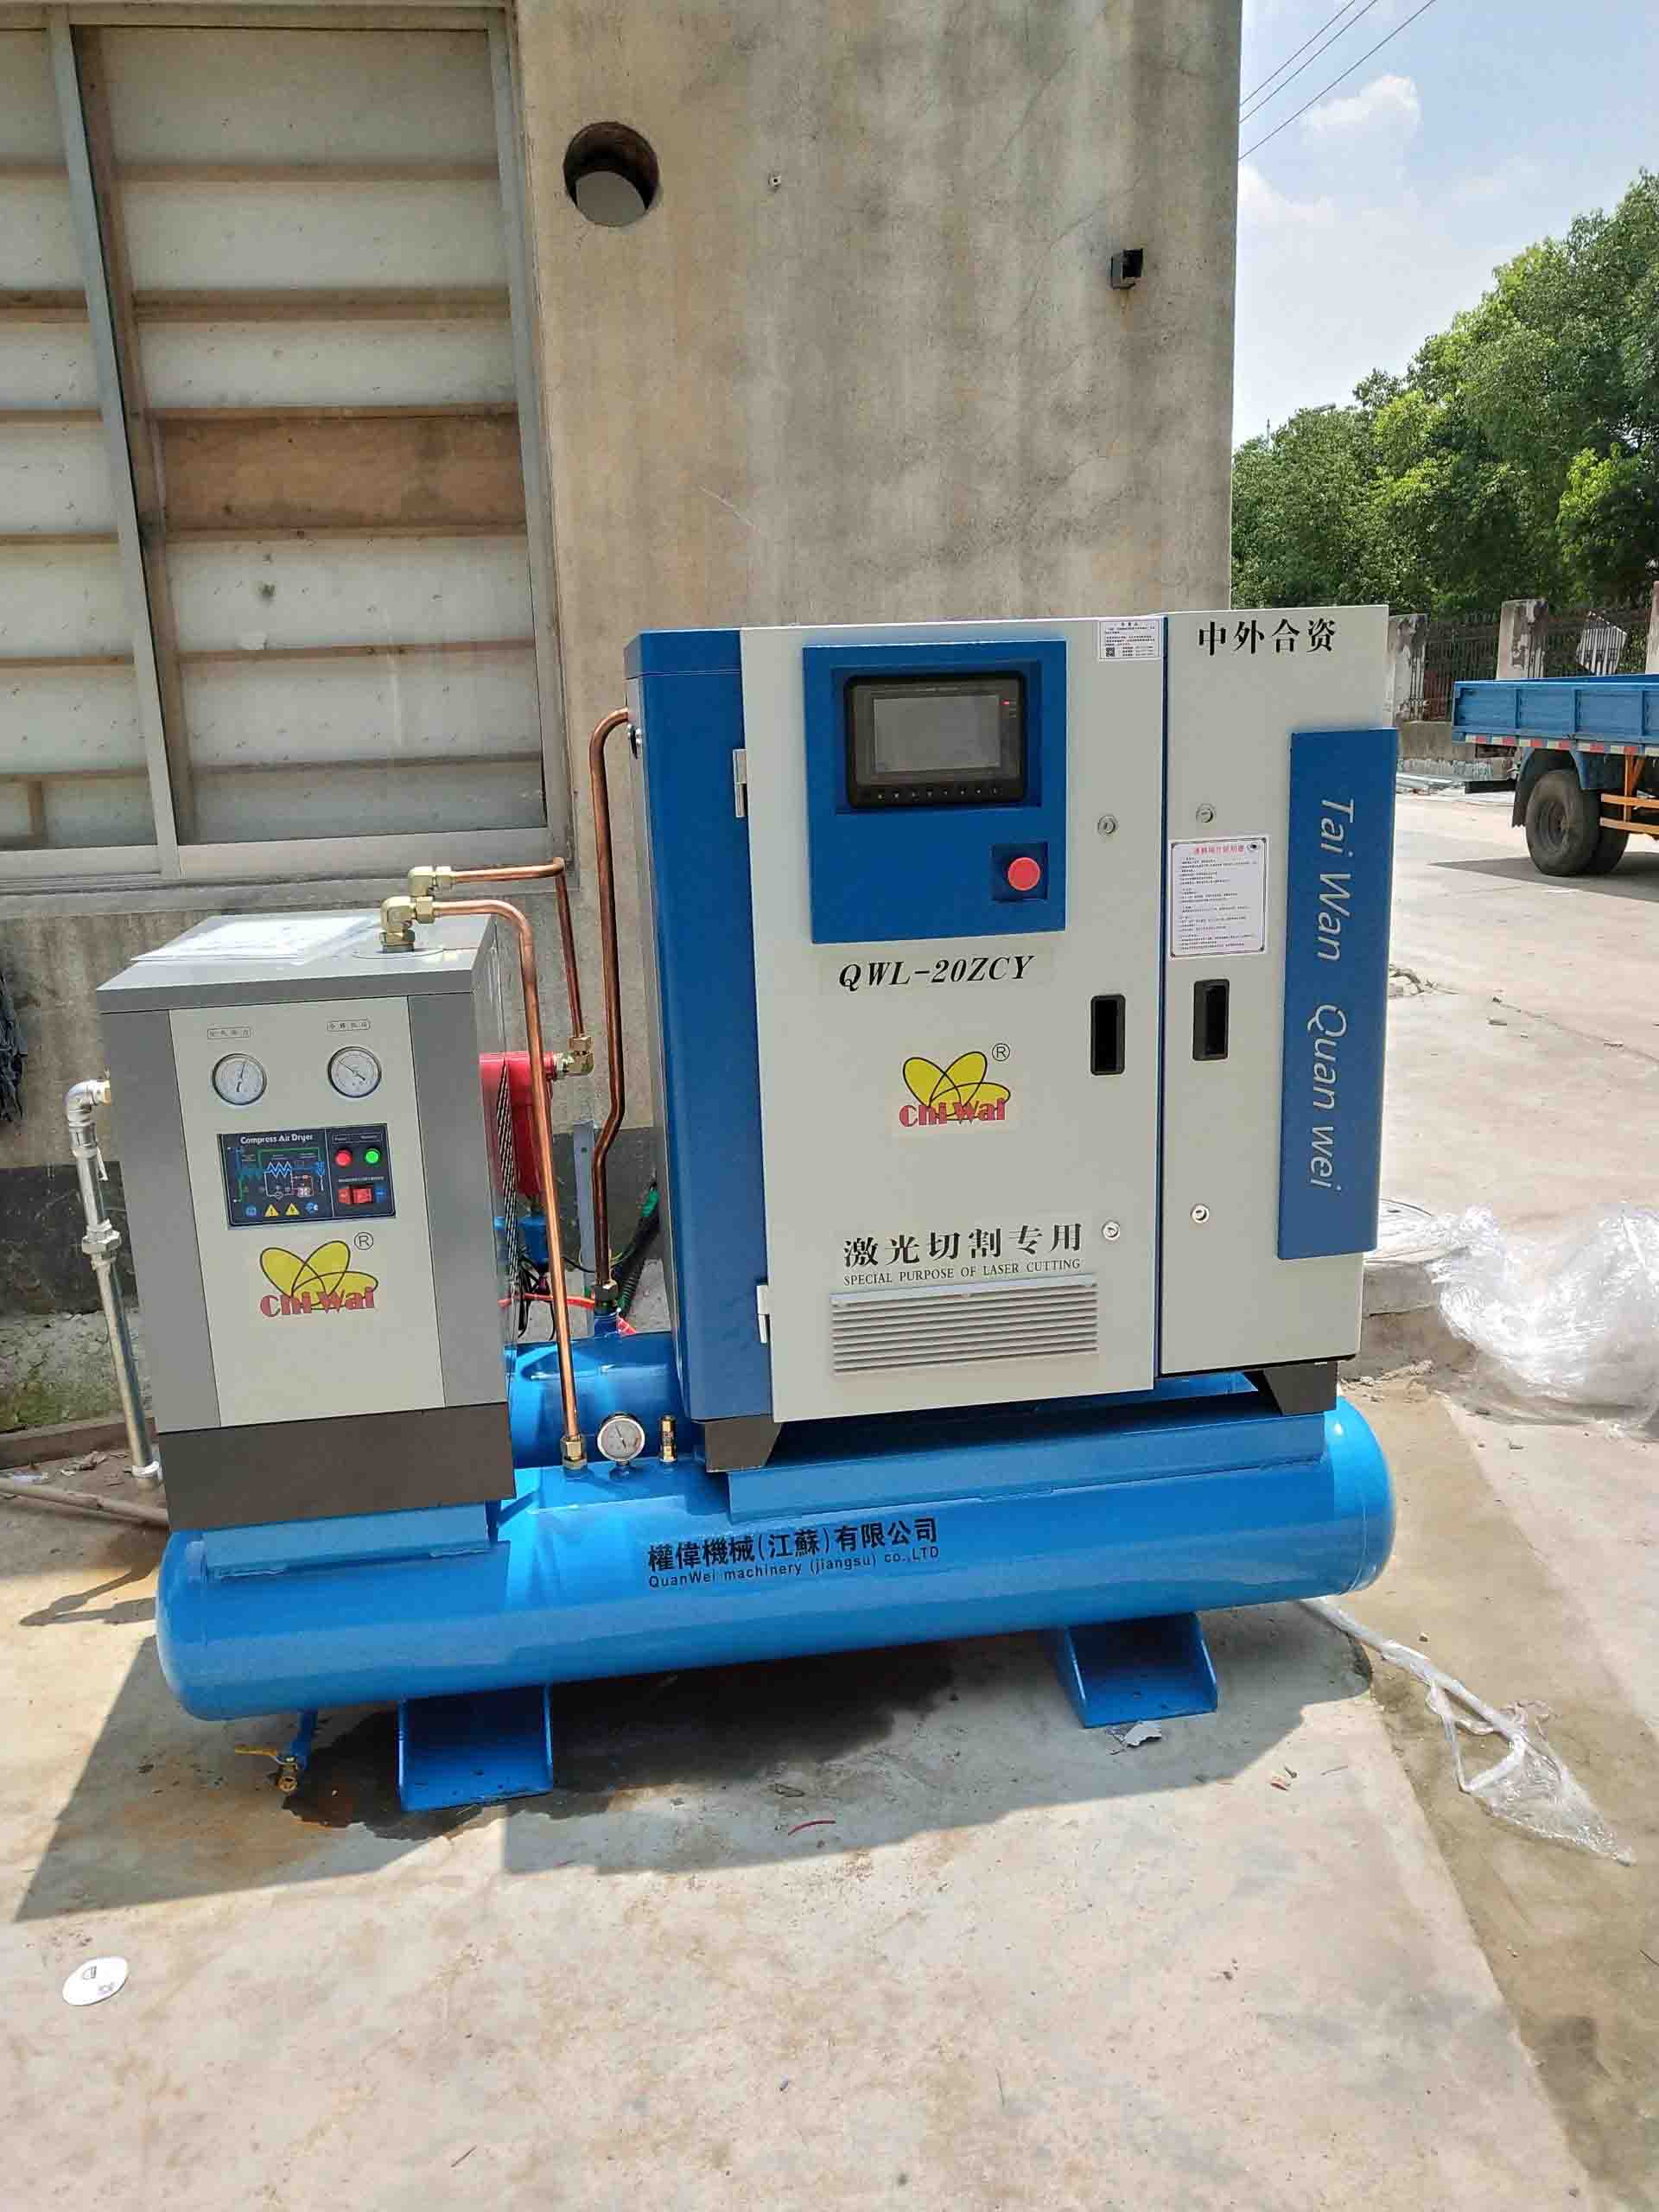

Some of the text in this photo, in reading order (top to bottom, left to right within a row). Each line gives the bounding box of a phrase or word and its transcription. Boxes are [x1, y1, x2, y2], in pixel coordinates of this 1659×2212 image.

[1198, 618, 1335, 656] 中外合资
[839, 956, 1034, 992] QWL-20ZCY
[1307, 798, 1355, 1192] Tai Wan Quan wei
[240, 1134, 276, 1145] Compress
[291, 1133, 314, 1141] Dryer
[843, 1223, 1081, 1268] 激光切割专用
[843, 1258, 1080, 1286] SPECIAL PURPOSE OF LASER CUTTING
[649, 1572, 715, 1587] QuanWei
[724, 1563, 801, 1580] machinery
[810, 1554, 877, 1574] (jiangsu)
